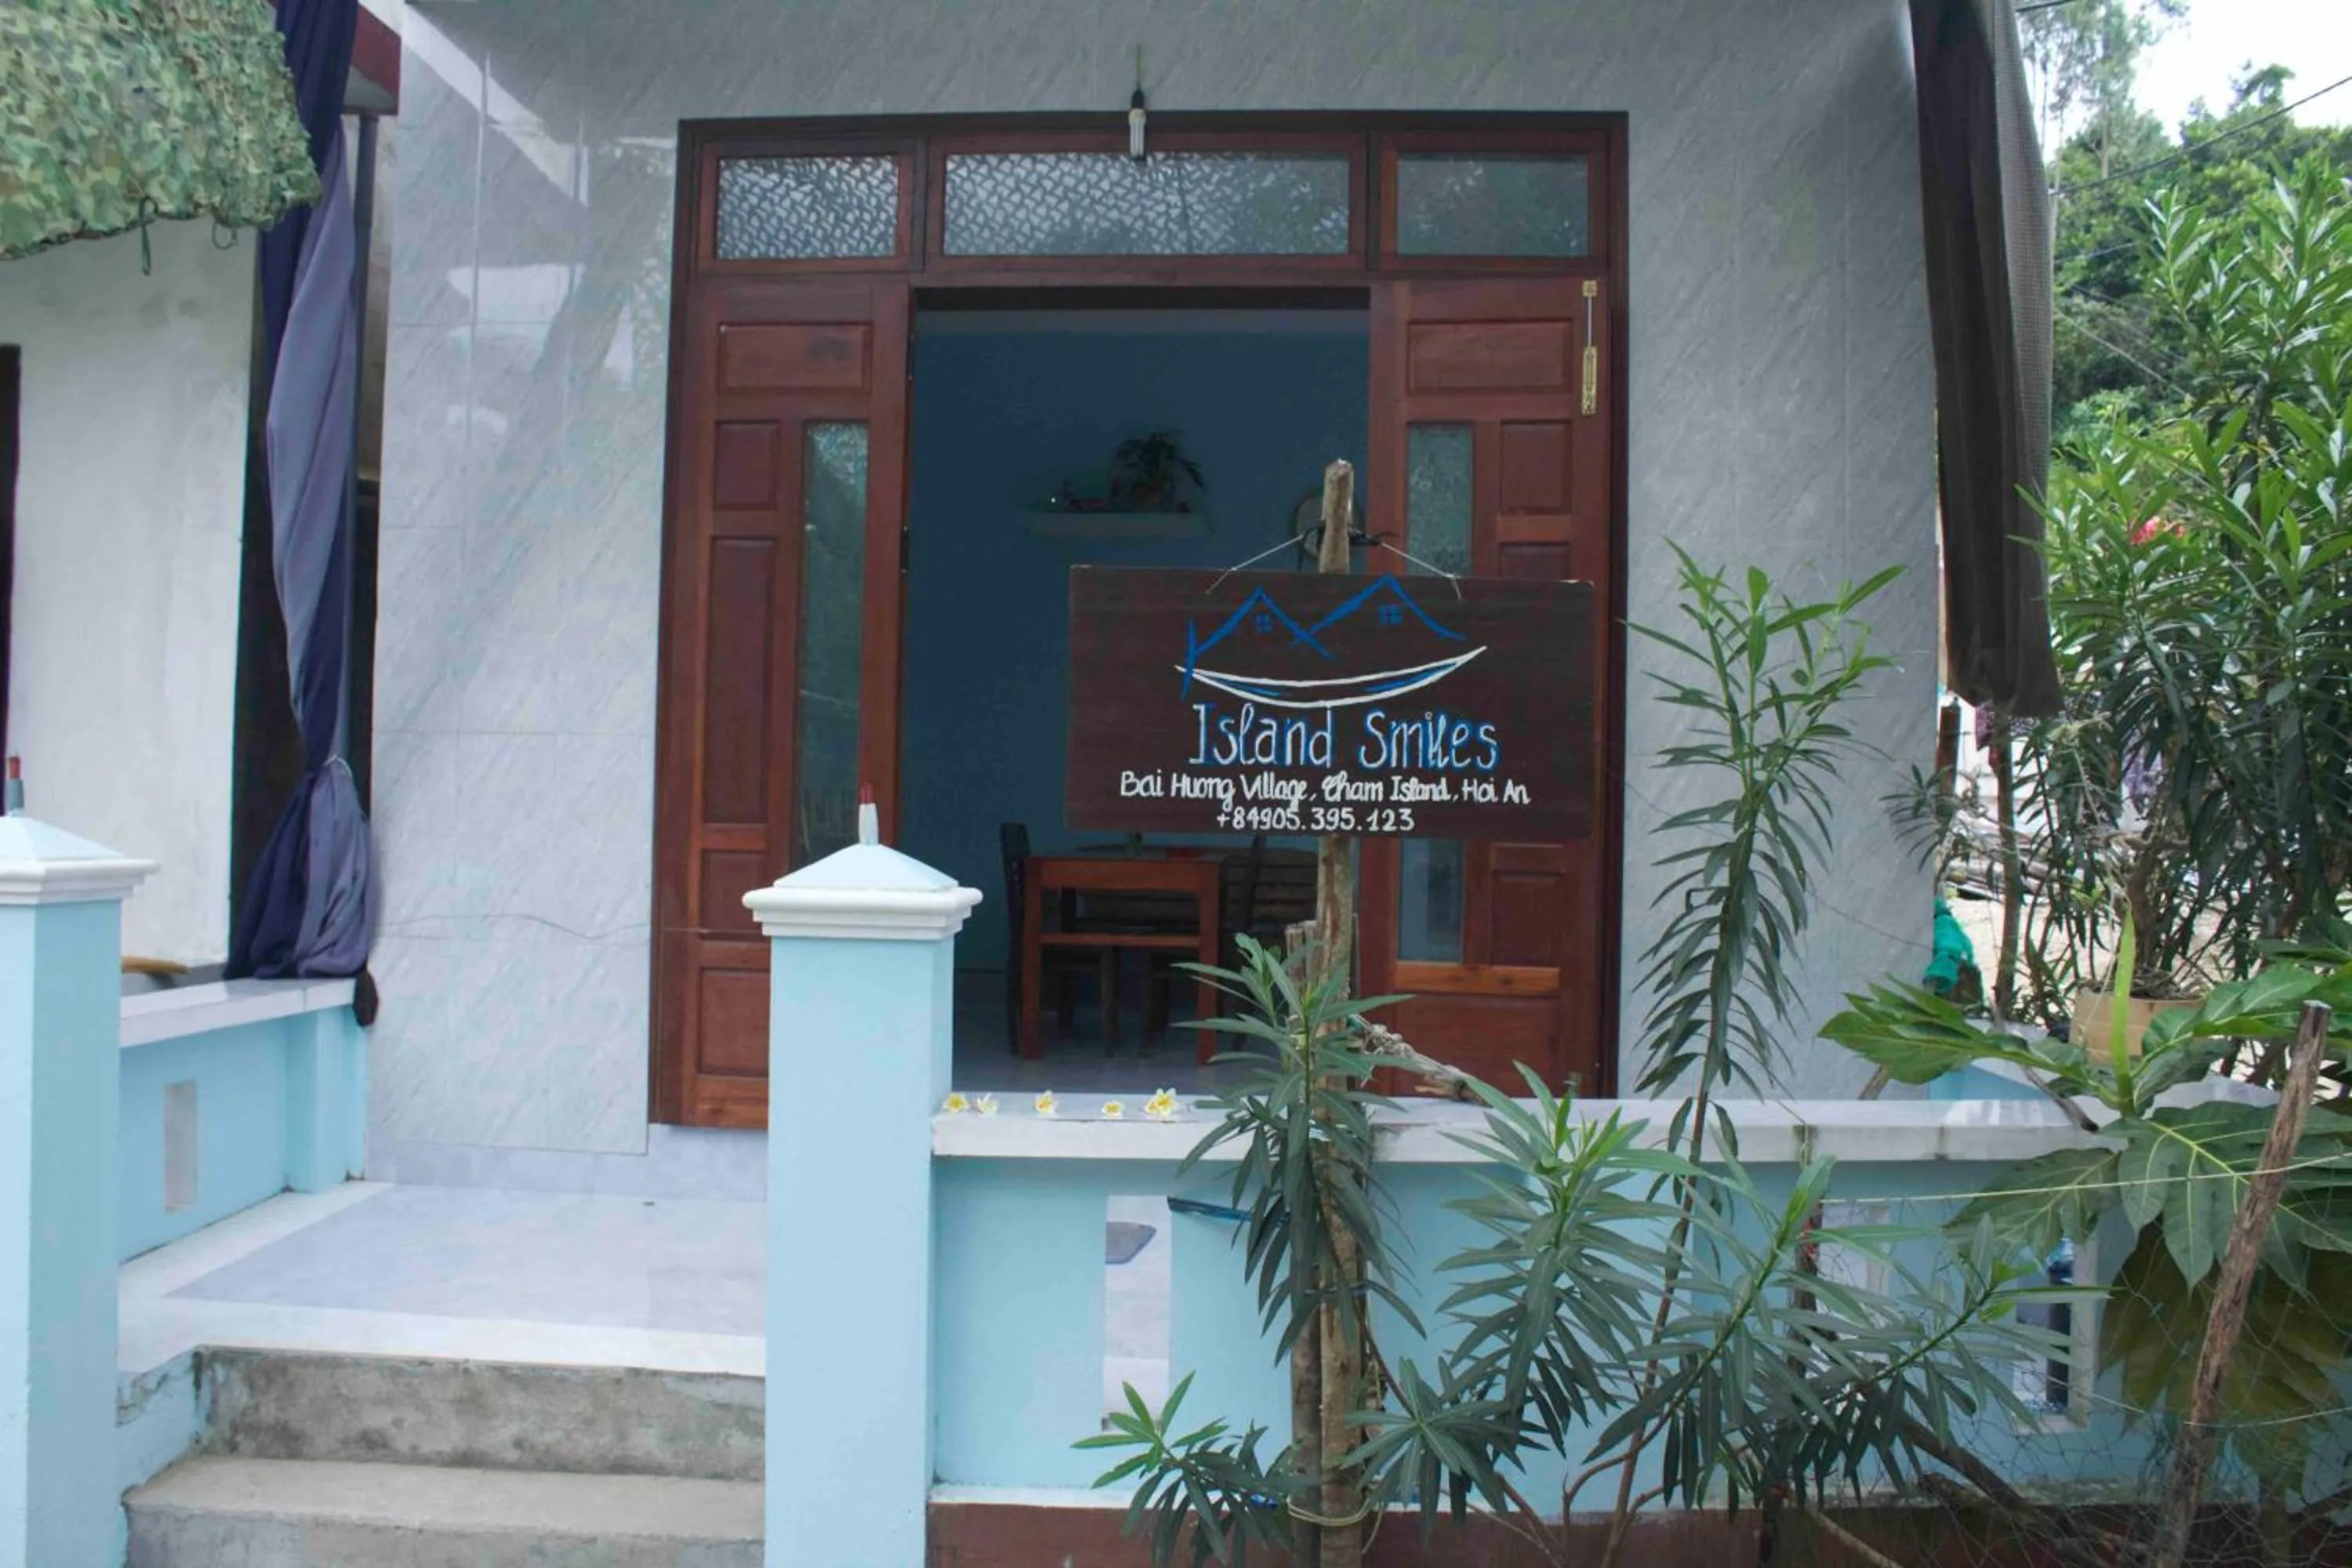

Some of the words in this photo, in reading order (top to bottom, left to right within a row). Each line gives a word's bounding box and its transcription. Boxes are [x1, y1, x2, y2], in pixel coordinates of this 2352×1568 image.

[1189, 702, 1332, 768] Island
[1359, 710, 1498, 769] Smiles
[1120, 768, 1164, 797] Bai
[1240, 771, 1317, 810] Village,
[1388, 775, 1459, 803] Island,
[1502, 779, 1531, 805] An
